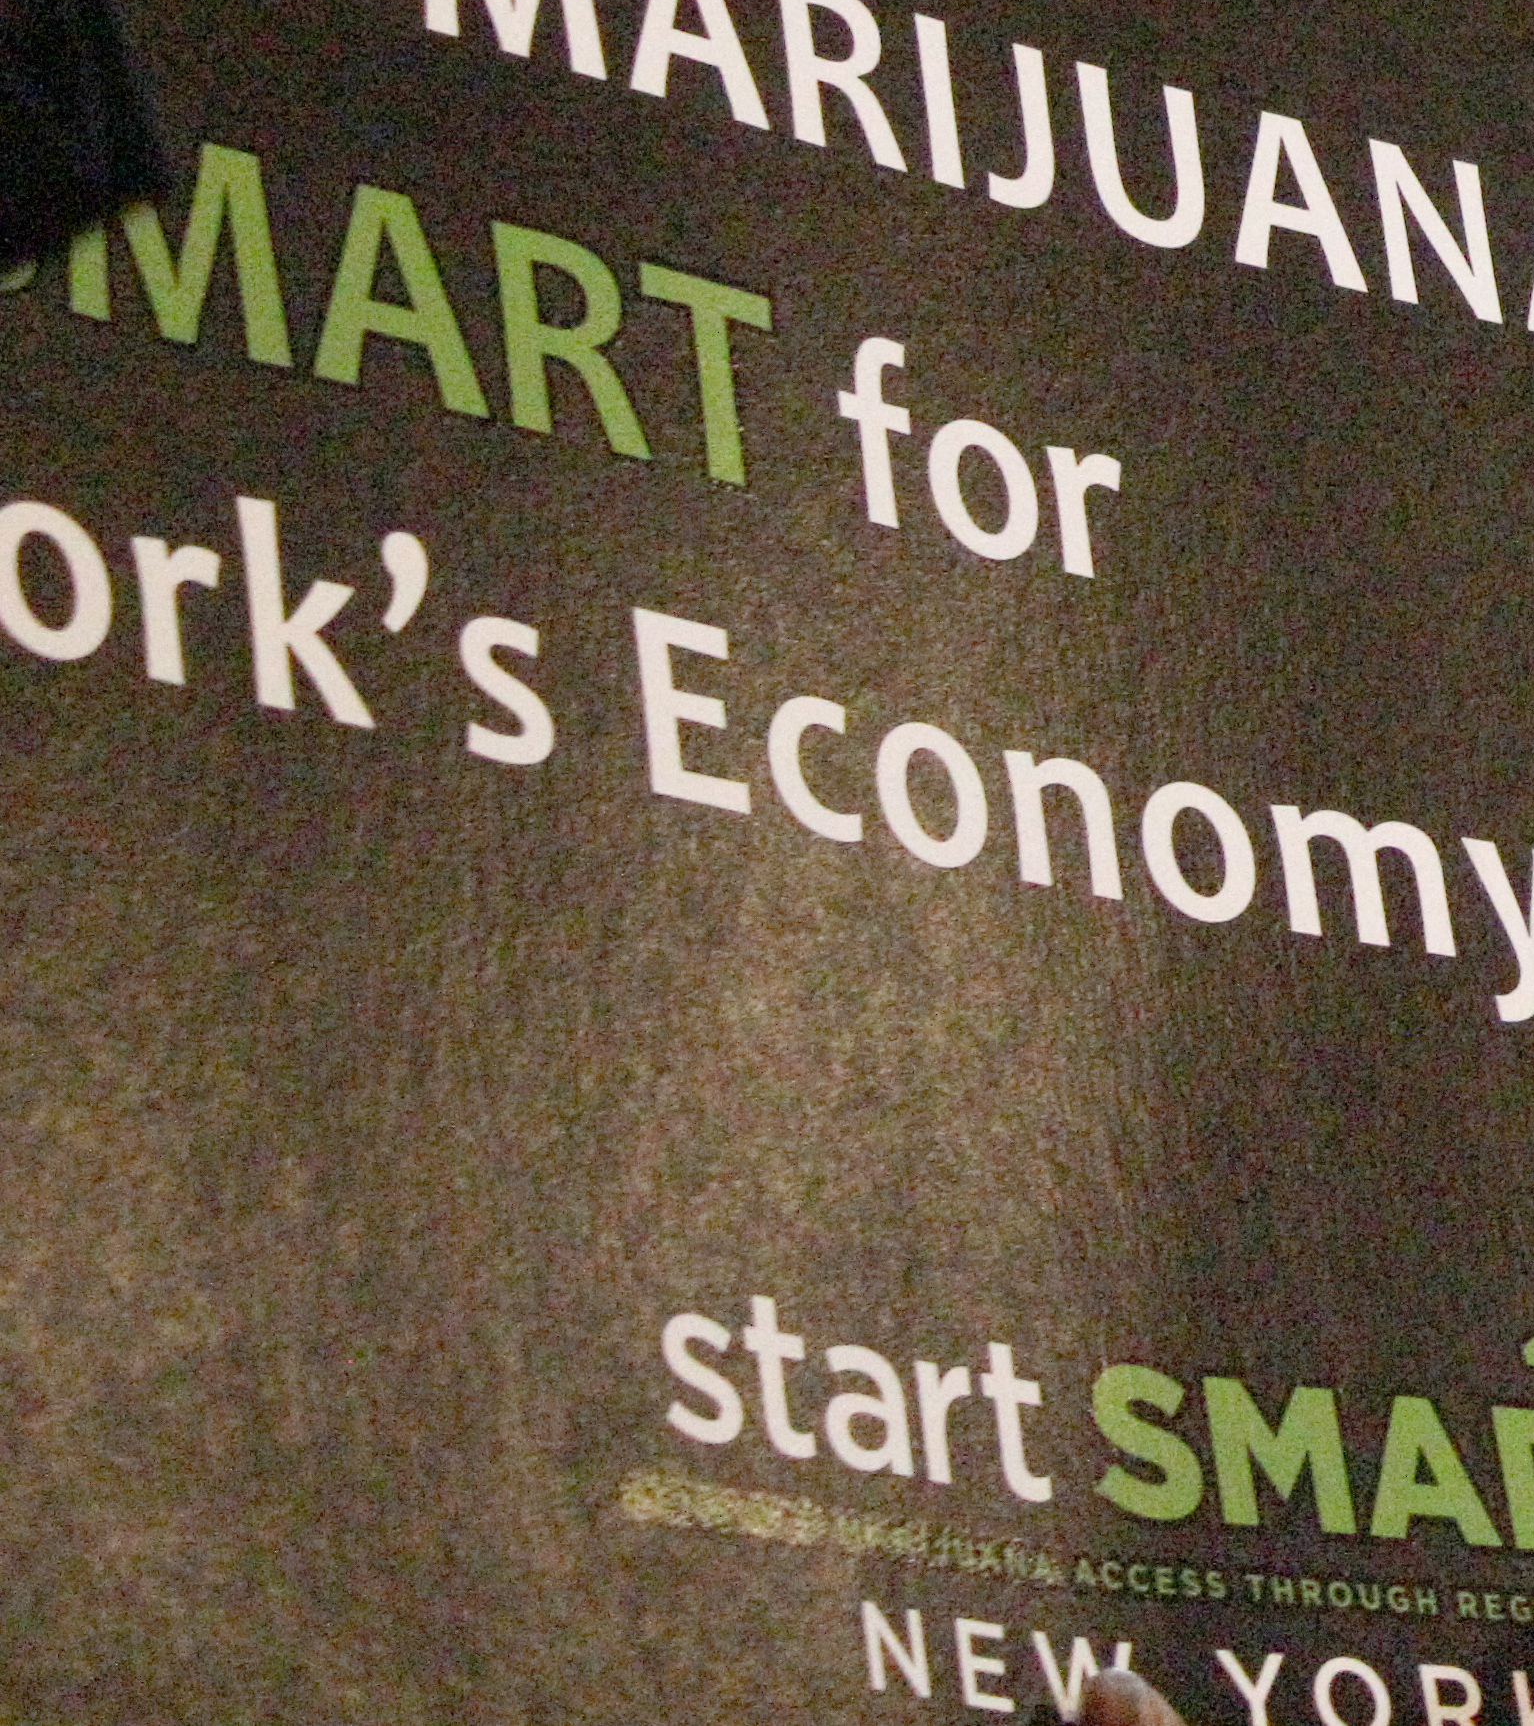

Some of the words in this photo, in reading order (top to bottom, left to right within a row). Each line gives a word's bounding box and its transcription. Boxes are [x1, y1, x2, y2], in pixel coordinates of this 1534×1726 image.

[0, 142, 773, 487] MART
[836, 336, 1122, 579] for
[660, 1294, 1054, 1504] start
[860, 1599, 1133, 1724] NEW
[1072, 1559, 1228, 1600] ACCESS
[1244, 1574, 1440, 1617] THROUGH
